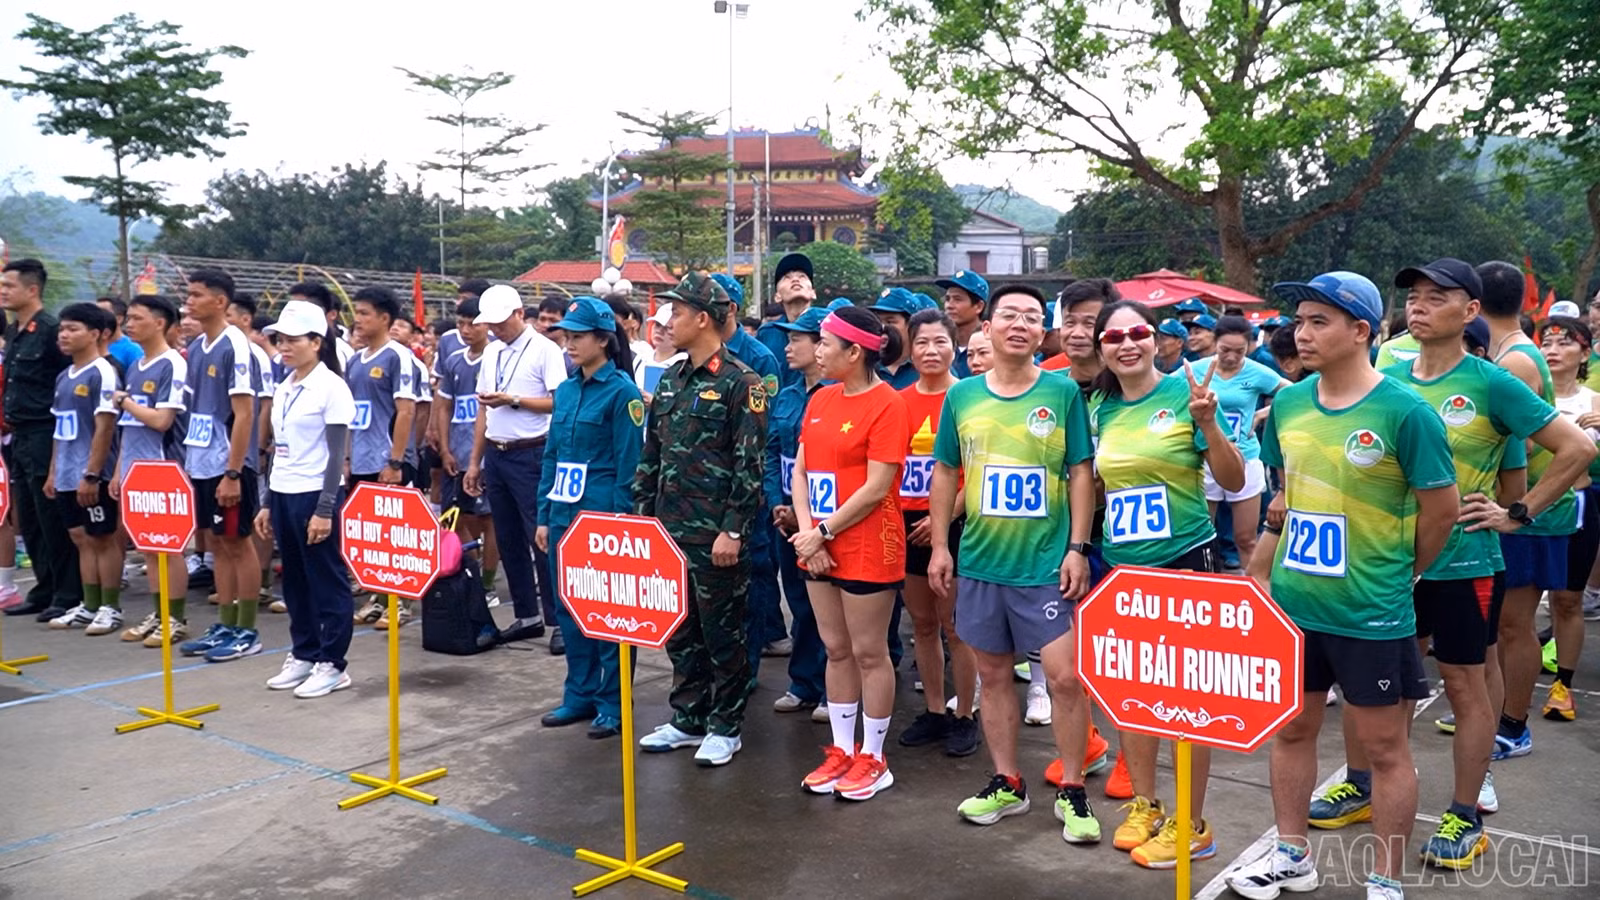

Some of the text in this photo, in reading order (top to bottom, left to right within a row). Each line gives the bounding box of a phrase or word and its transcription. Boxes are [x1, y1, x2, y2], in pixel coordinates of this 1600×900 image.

[128, 488, 188, 518] TRỌNG TÀI
[374, 495, 403, 519] BAN
[988, 472, 1042, 511] 193
[87, 505, 105, 523] 19
[345, 512, 362, 540] CHỈ
[363, 521, 382, 543] HUY
[390, 522, 418, 549] QUÂN
[419, 528, 436, 556] SỰ
[1111, 491, 1167, 537] 275
[350, 546, 431, 574] P. NAM CƯỜNG
[588, 530, 651, 560] ĐOÀN
[1288, 517, 1341, 567] 220
[566, 560, 679, 614] PHƯỜNG NAM CƯỜNG
[1115, 588, 1254, 636] CÂU LẠC BỘ
[1092, 628, 1281, 704] YÊN BÁI RUNNER
